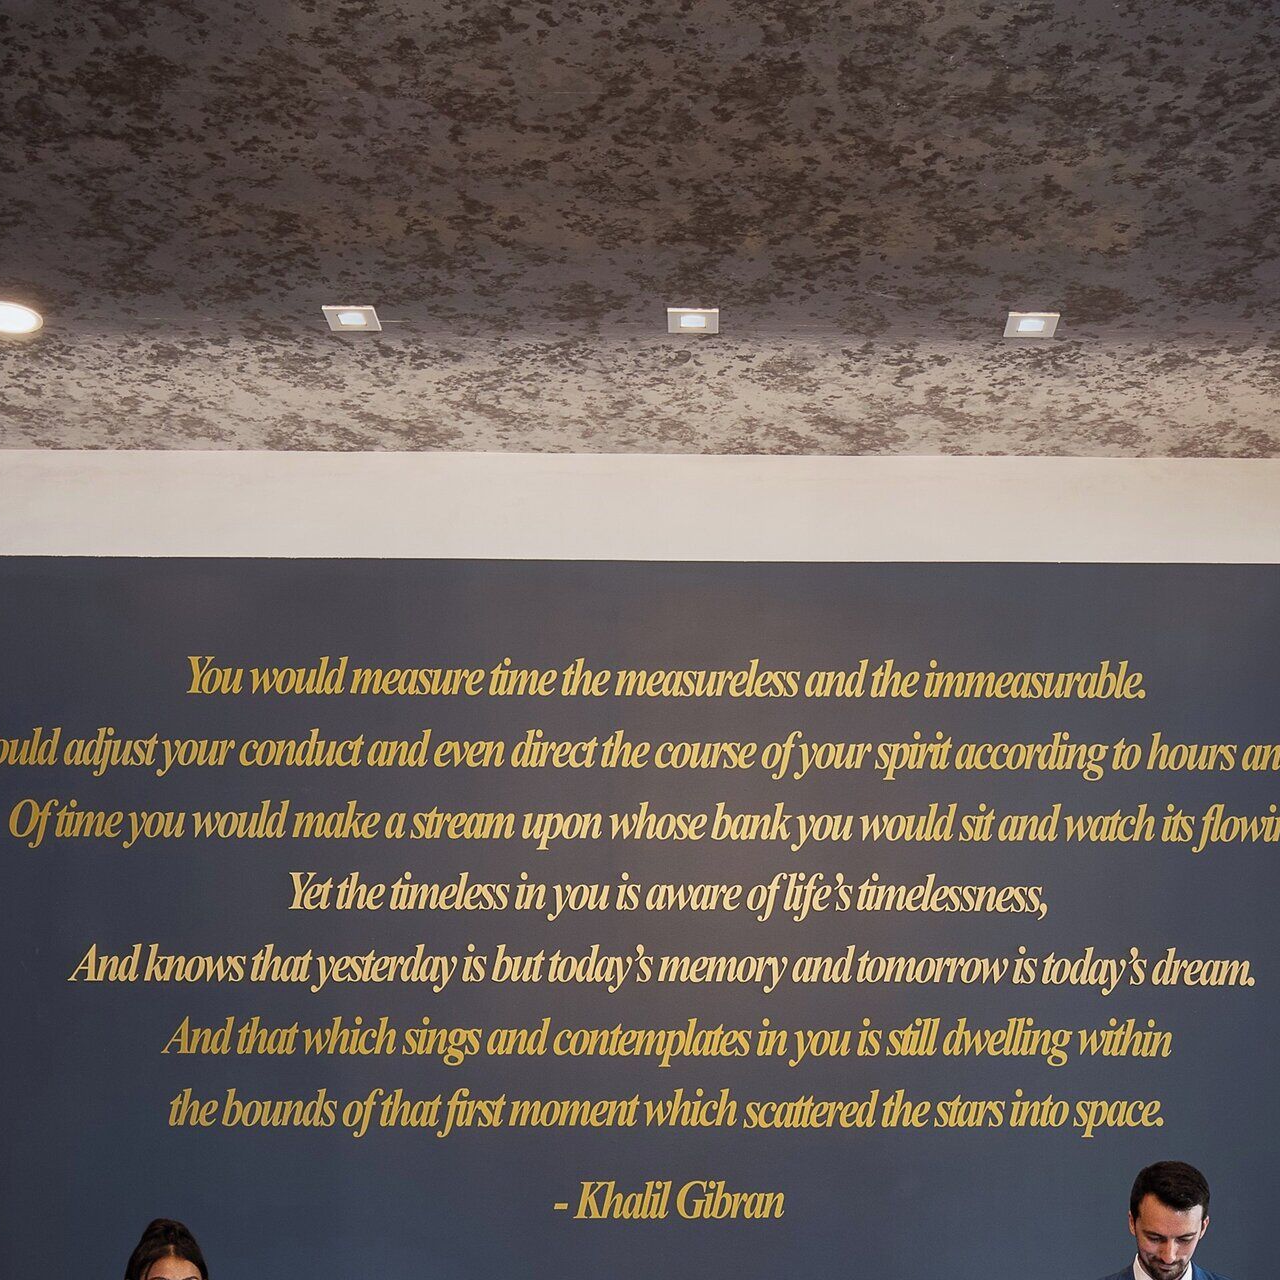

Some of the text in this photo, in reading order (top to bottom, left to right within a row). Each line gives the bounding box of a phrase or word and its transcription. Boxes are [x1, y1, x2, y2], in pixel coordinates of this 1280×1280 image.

[188, 655, 1146, 700] You would measure time the measureless and the immeasurable.
[63, 726, 159, 777] adjust
[156, 738, 236, 777] your
[238, 727, 365, 768] conduct
[366, 728, 432, 768] and
[433, 739, 506, 768] even
[510, 728, 599, 768] direct
[599, 728, 652, 769] the
[651, 740, 760, 771] course
[760, 730, 804, 781] of
[790, 741, 873, 781] your
[873, 730, 953, 782] spirit
[954, 731, 1109, 782] according
[1111, 739, 1142, 771] to
[1146, 732, 1238, 771] hours
[9, 799, 59, 848] Of
[55, 800, 124, 838] time
[121, 811, 185, 848] you
[193, 800, 291, 839] would
[292, 800, 382, 840] make
[384, 811, 407, 840] a
[408, 806, 517, 840] stream
[520, 811, 603, 852] upon
[607, 800, 708, 841] whose
[710, 801, 793, 841] bank
[790, 813, 856, 853] you
[859, 801, 958, 841] would
[958, 803, 996, 842] sit
[997, 803, 1062, 842] and
[1065, 803, 1156, 843] watch
[1160, 804, 1196, 842] its
[290, 871, 1048, 922] Yet the timeless in you is aware of life’s timelessness,
[68, 943, 1255, 996] And knows that yesterday is but today’s memory and tomorrow is today’s dream.
[162, 1015, 1172, 1069] And that which sings and contemplates in you is still dwelling within
[169, 1088, 1164, 1139] the bounds of that first moment which scattered the stars into space.
[574, 1180, 672, 1220] Khalil
[675, 1180, 784, 1220] Gibran
